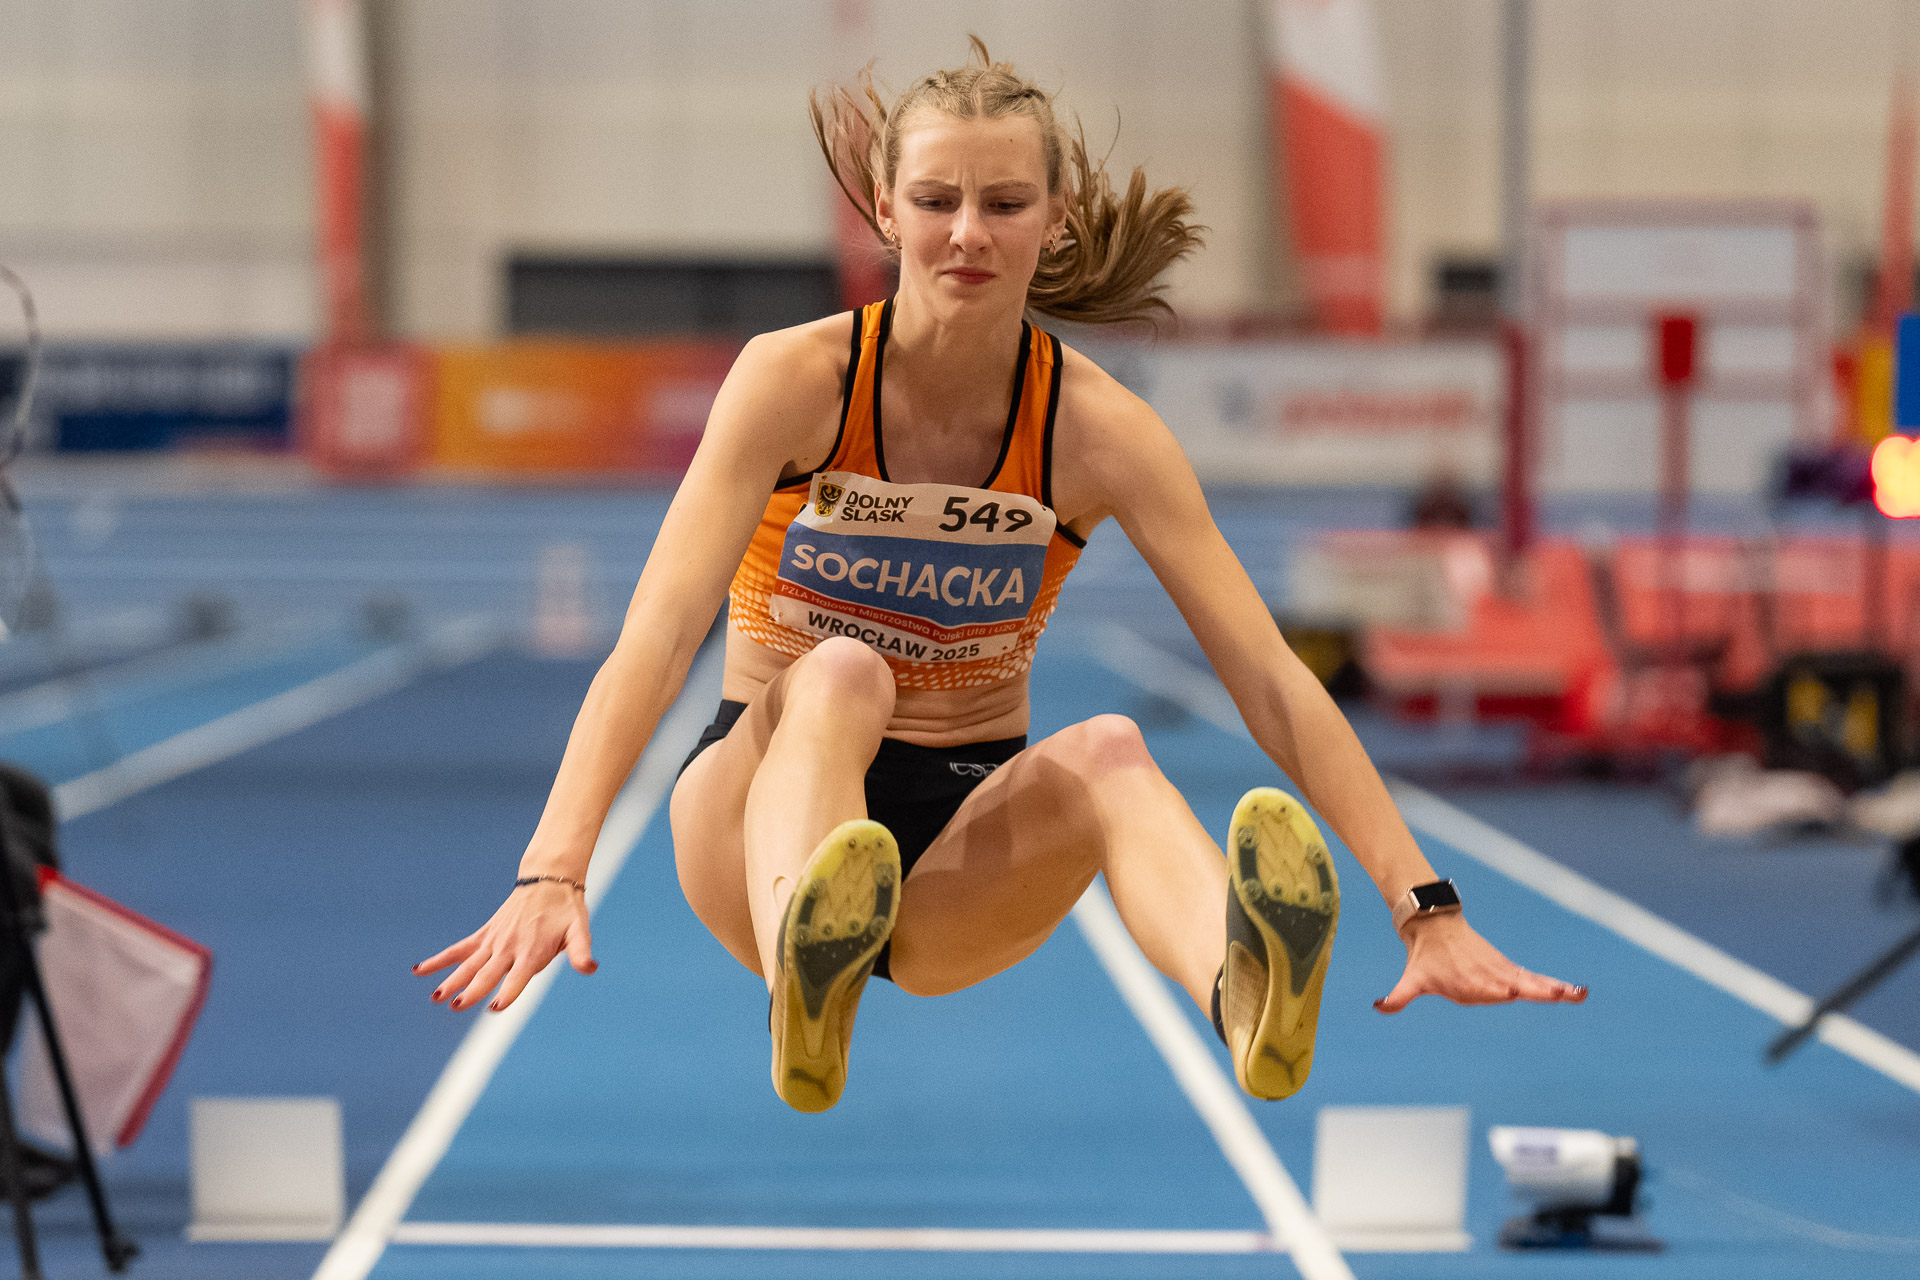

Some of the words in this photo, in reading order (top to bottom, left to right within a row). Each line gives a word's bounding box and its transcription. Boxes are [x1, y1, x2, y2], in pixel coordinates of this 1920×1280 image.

[840, 504, 907, 523] ŚLĄSK
[845, 490, 914, 509] DOLNY
[938, 496, 1033, 533] 549
[791, 544, 1024, 607] SOCHACKA
[780, 584, 808, 599] PZLA
[859, 608, 930, 634] Mistrzostwa
[932, 629, 965, 641] Polski
[967, 627, 986, 637] U18
[995, 623, 1016, 633] U20
[808, 610, 927, 659] WROCŁAW
[930, 643, 980, 661] 2025
